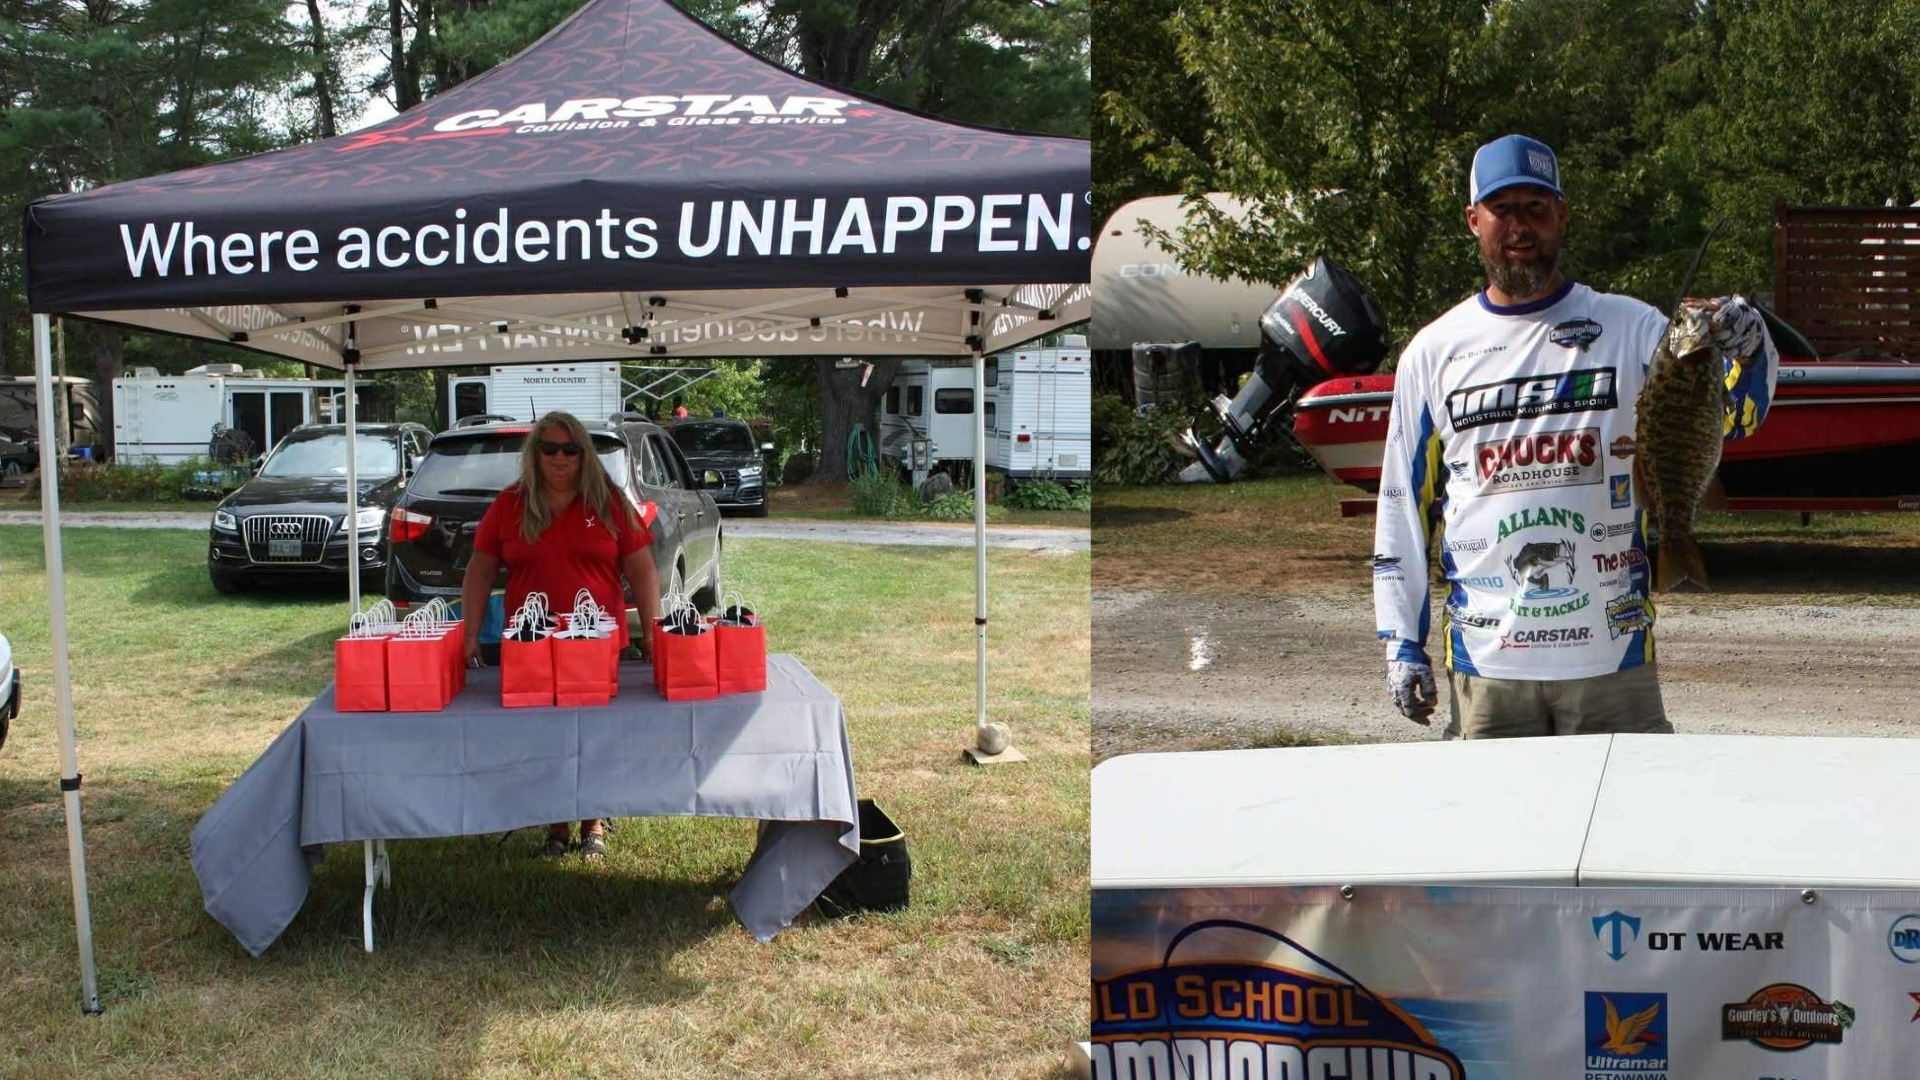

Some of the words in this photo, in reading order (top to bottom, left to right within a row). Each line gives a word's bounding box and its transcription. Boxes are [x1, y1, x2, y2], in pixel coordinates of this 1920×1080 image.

[433, 94, 849, 132] CARSTAR
[515, 119, 631, 135] Collision
[637, 117, 657, 128] &
[667, 116, 742, 127] Glass
[748, 115, 848, 125] Service
[119, 221, 320, 279] Where
[336, 207, 660, 271] accidents
[677, 192, 1091, 259] UNHAPPEN.
[1291, 287, 1347, 336] MERCURY
[523, 376, 550, 384] NORTH
[552, 375, 588, 384] COUNTRY
[1454, 409, 1514, 428] INDUSTRIAL
[1517, 402, 1560, 415] MARINE
[1564, 401, 1571, 409] &
[1575, 398, 1609, 409] SPORT
[1478, 432, 1597, 481] CHUCK'S
[1493, 465, 1581, 485] ROADHOUSE
[1496, 506, 1586, 545] ALLAN'S
[1592, 552, 1619, 574] The
[1531, 606, 1541, 618] &
[1543, 592, 1590, 617] TACKLE
[1696, 931, 1785, 951] WEAR
[1174, 974, 1370, 1028] SCHOOL
[1727, 1008, 1777, 1024] Gourley's
[1792, 1008, 1839, 1027] Outdoors
[1586, 1055, 1667, 1070] Ultramar
